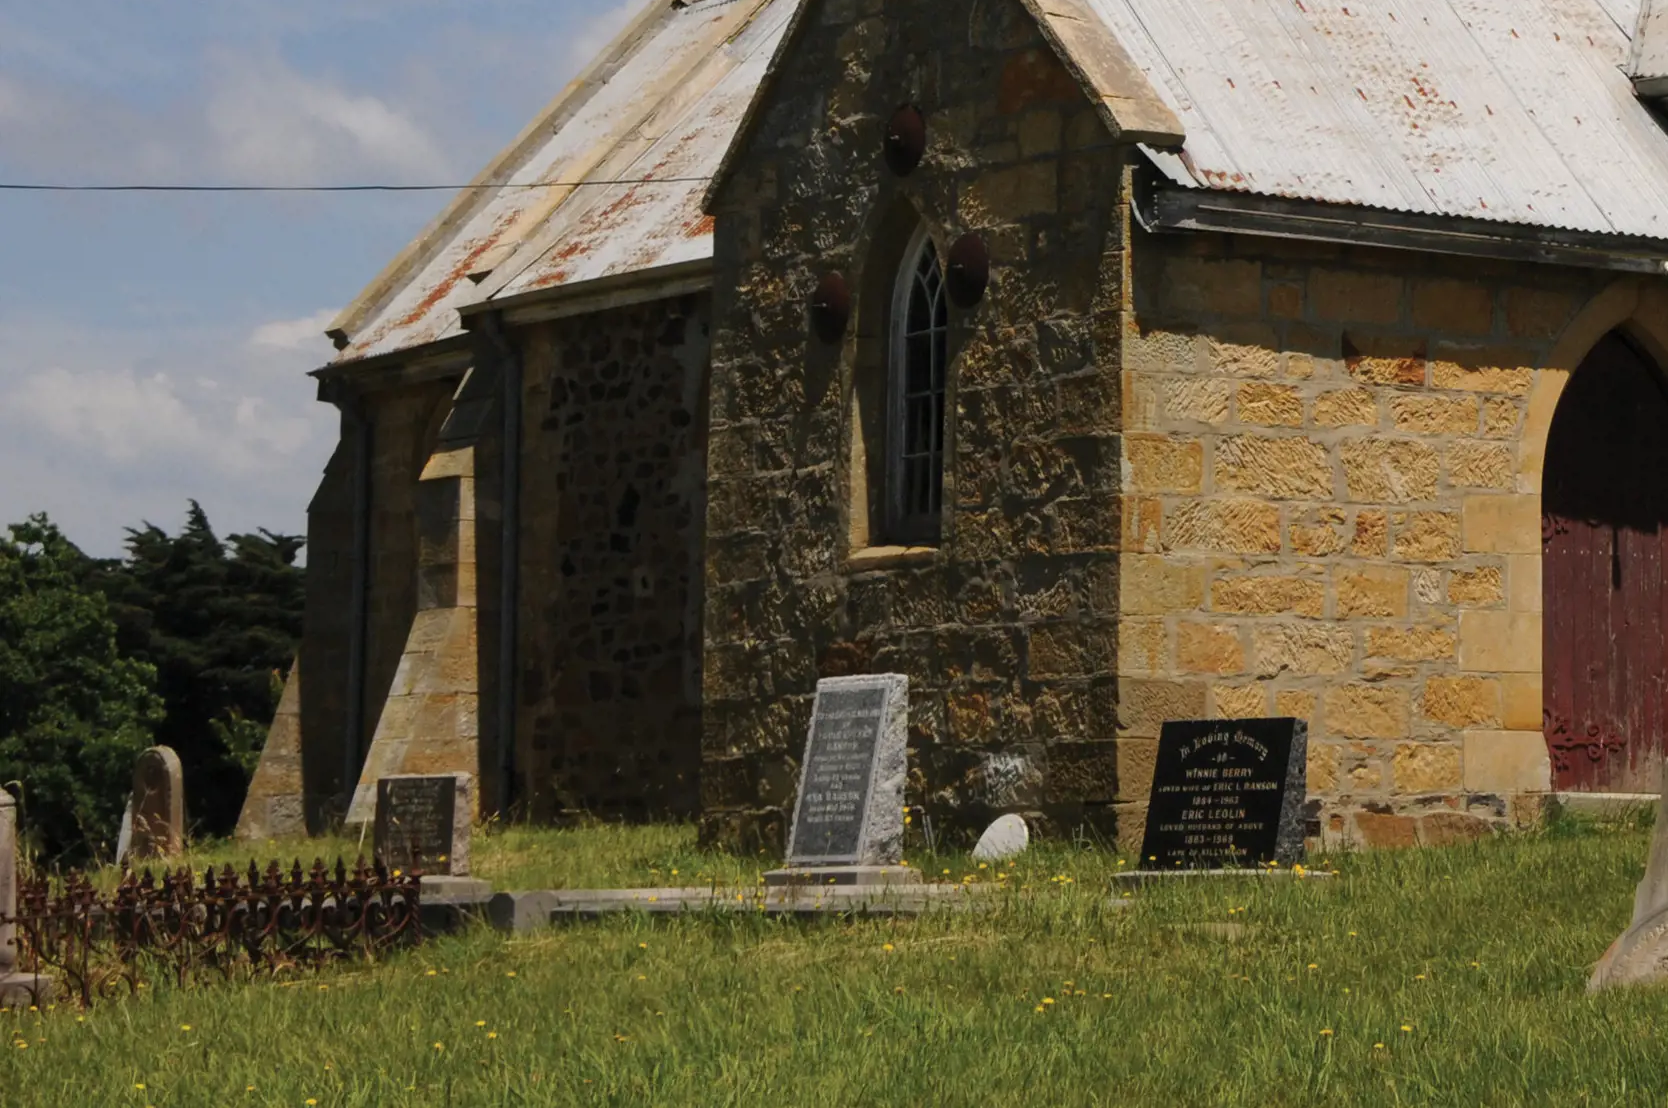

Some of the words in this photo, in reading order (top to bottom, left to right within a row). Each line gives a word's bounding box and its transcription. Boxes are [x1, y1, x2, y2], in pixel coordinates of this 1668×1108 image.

[1193, 731, 1229, 753] Loving
[1185, 768, 1217, 778] WINNIE
[1222, 768, 1252, 777] BERRY
[1212, 782, 1233, 792] ERIC
[1182, 811, 1204, 820] ERIC
[1208, 809, 1245, 819] LEOLIN
[1160, 823, 1184, 832] LOVED
[1187, 823, 1221, 832] HUSBAND
[1225, 823, 1234, 831] OF
[1238, 822, 1264, 831] ABOVE
